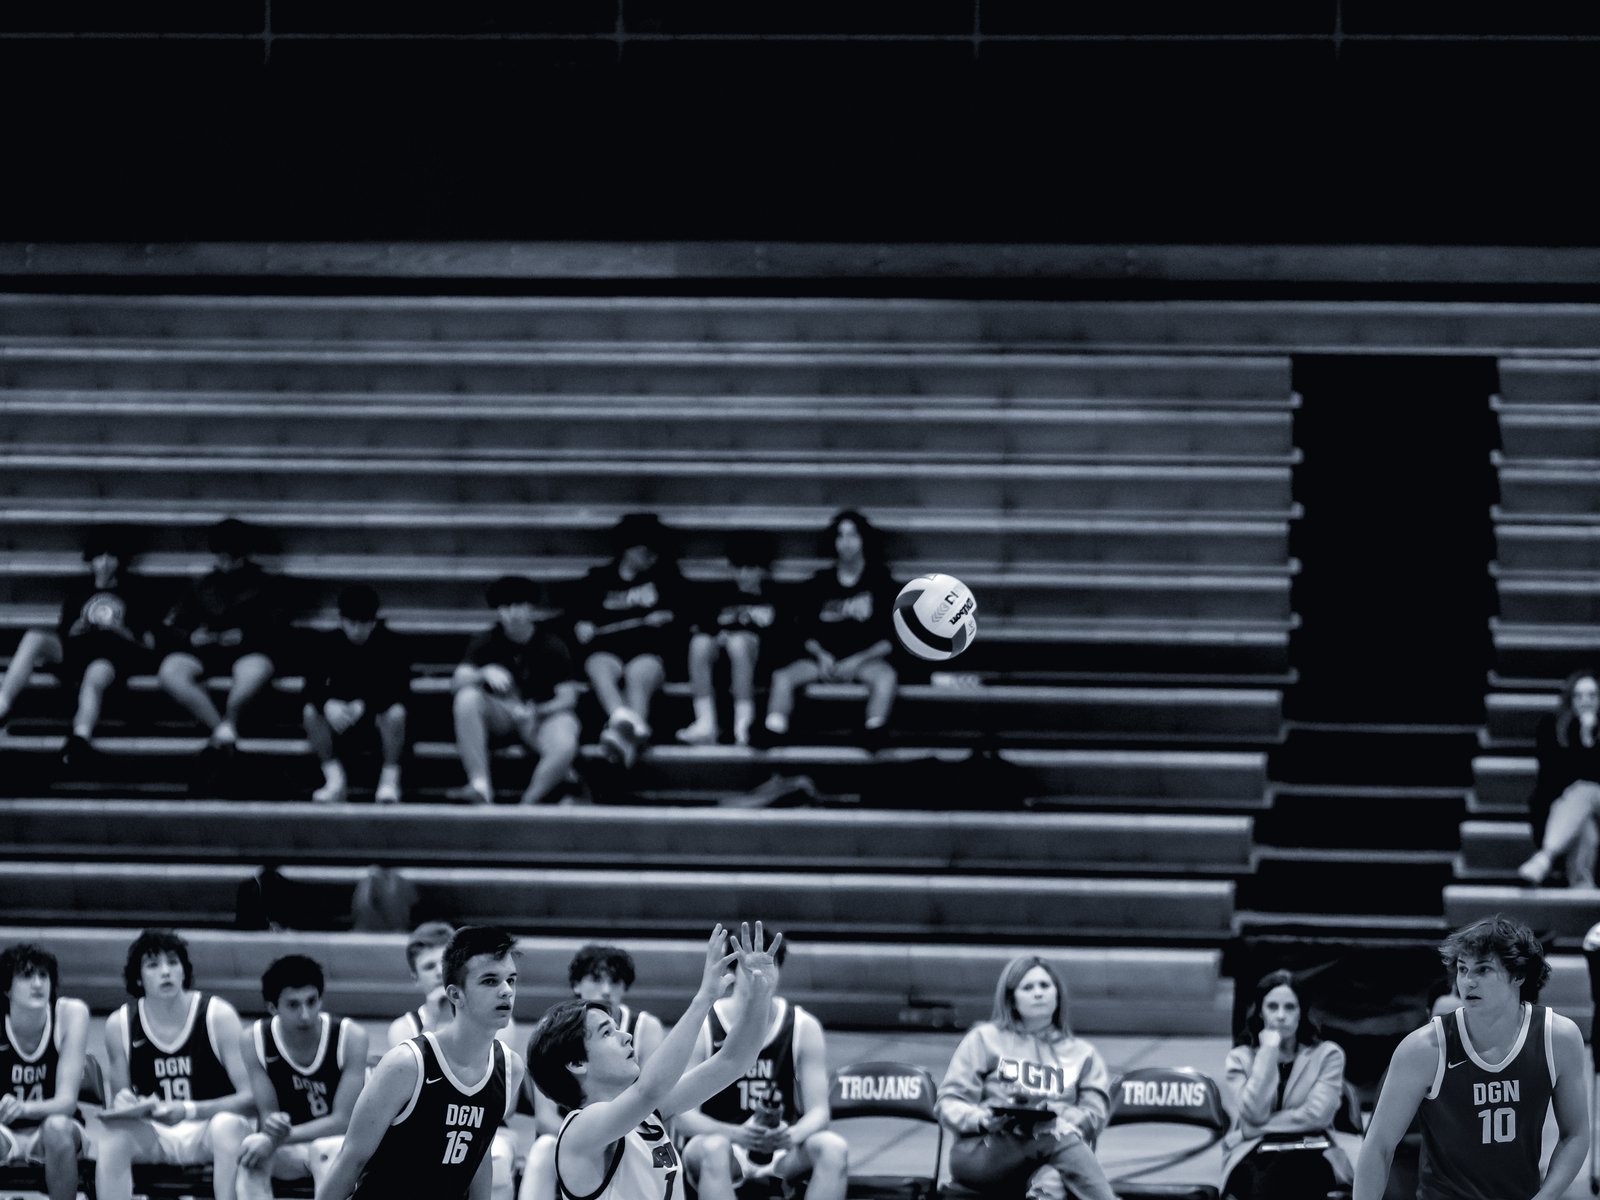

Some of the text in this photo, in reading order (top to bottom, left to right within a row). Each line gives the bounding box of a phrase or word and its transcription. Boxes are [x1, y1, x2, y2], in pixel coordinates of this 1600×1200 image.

[949, 597, 974, 625] Wilson
[11, 1063, 47, 1084] DGN
[154, 1056, 192, 1078] DGN
[998, 1057, 1066, 1096] DGN
[159, 1078, 192, 1103] 19
[838, 1075, 922, 1101] TROJANS
[1122, 1081, 1207, 1107] TROJANS
[1473, 1080, 1520, 1106] DGN
[445, 1103, 485, 1129] DGN
[1477, 1107, 1516, 1145] 10
[442, 1130, 474, 1165] 16
